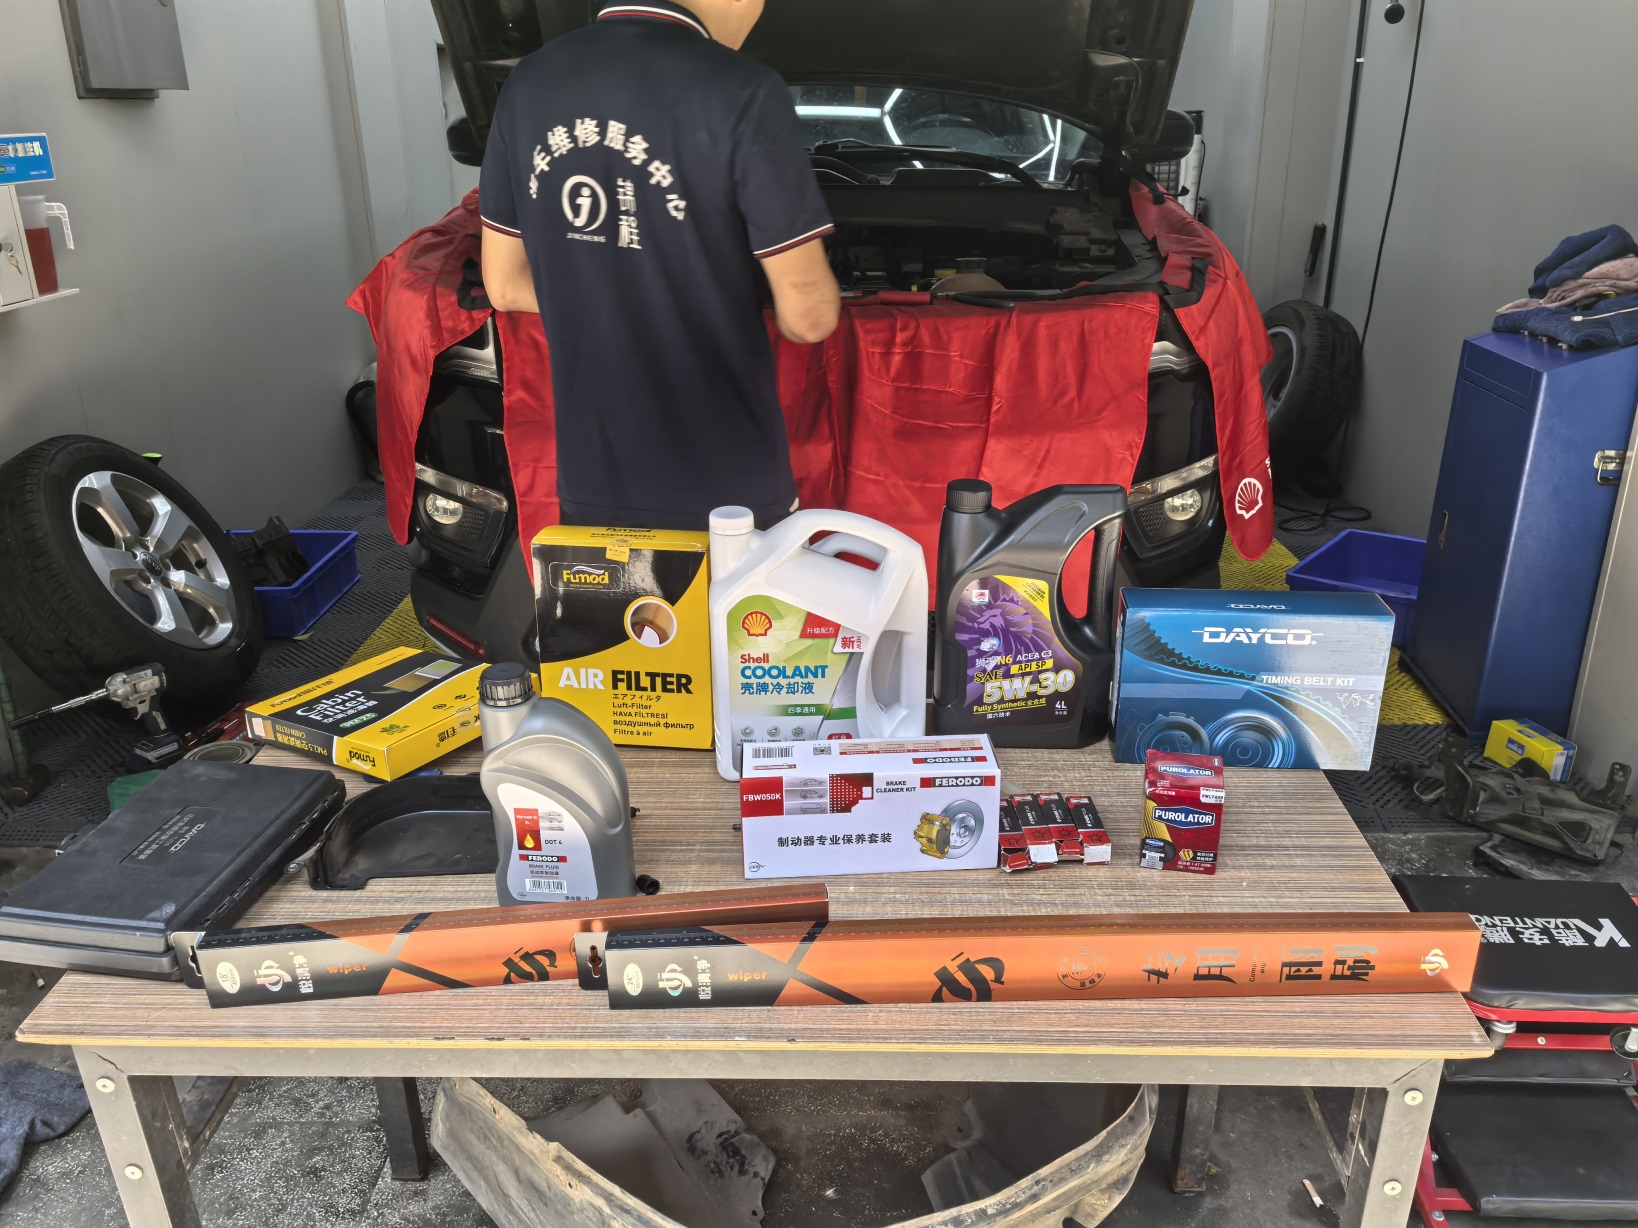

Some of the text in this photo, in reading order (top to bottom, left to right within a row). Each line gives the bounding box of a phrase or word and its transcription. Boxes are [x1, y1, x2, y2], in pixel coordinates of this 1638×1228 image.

[562, 569, 609, 585] Fumod
[806, 627, 835, 635] 升级配方
[1202, 626, 1314, 645] DAYCO
[840, 636, 855, 650] 新
[740, 653, 770, 664] Shell
[1016, 650, 1053, 662] ACEA C3
[740, 665, 828, 680] COOLANT
[1017, 661, 1047, 673] API SP
[558, 667, 694, 695] AIR FILTER
[974, 669, 1003, 683] SAE
[1261, 674, 1356, 687] TIMING BELT KIT
[740, 681, 815, 696] 壳牌冷却液
[983, 668, 1076, 704] 5W-30
[296, 688, 364, 717] Cabin
[612, 693, 663, 703] エアフィルタ
[307, 695, 367, 724] Filter
[612, 702, 653, 711] Luft-Filter
[787, 706, 816, 714] 四季通用
[973, 705, 992, 714] Fully
[992, 701, 1026, 711] Synthetic
[1055, 701, 1067, 709] 4L
[612, 710, 633, 719] HAVA
[613, 719, 695, 731] воздушный фильтр
[613, 728, 653, 737] Filtre à air
[348, 750, 376, 767] Fumod
[1160, 766, 1213, 776] PUROLATOR
[935, 777, 982, 787] FERODO
[876, 786, 904, 794] CLEANER
[743, 792, 782, 802] FBW050K
[1155, 809, 1213, 824] PUROLATOR
[777, 832, 893, 848] 制动器专业保养套装
[326, 962, 368, 975] wiper
[728, 970, 768, 982] wiper
